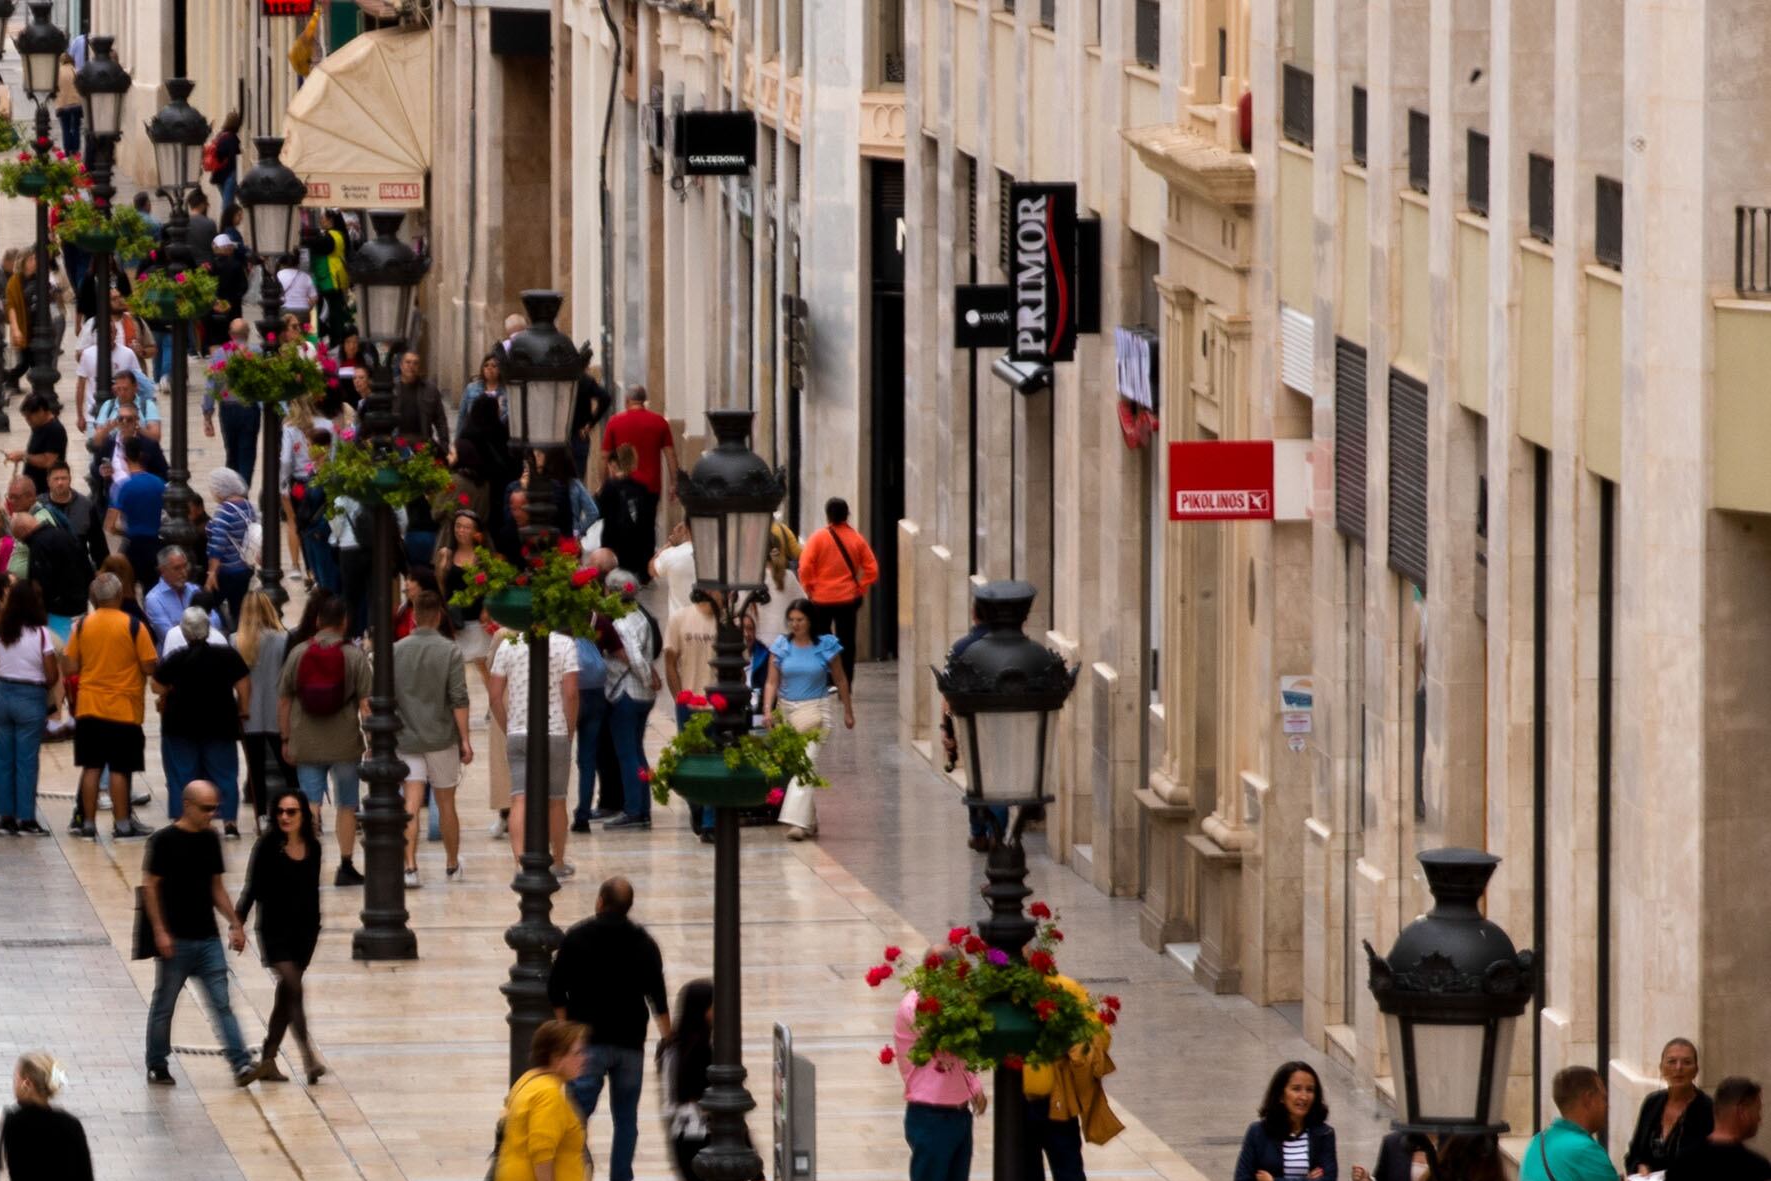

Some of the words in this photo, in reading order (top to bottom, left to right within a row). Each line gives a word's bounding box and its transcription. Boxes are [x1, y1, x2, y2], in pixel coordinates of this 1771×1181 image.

[688, 155, 746, 165] CALZEDONIA
[1017, 194, 1047, 355] PRIMOR
[1180, 493, 1245, 509] PIKOLINOS
